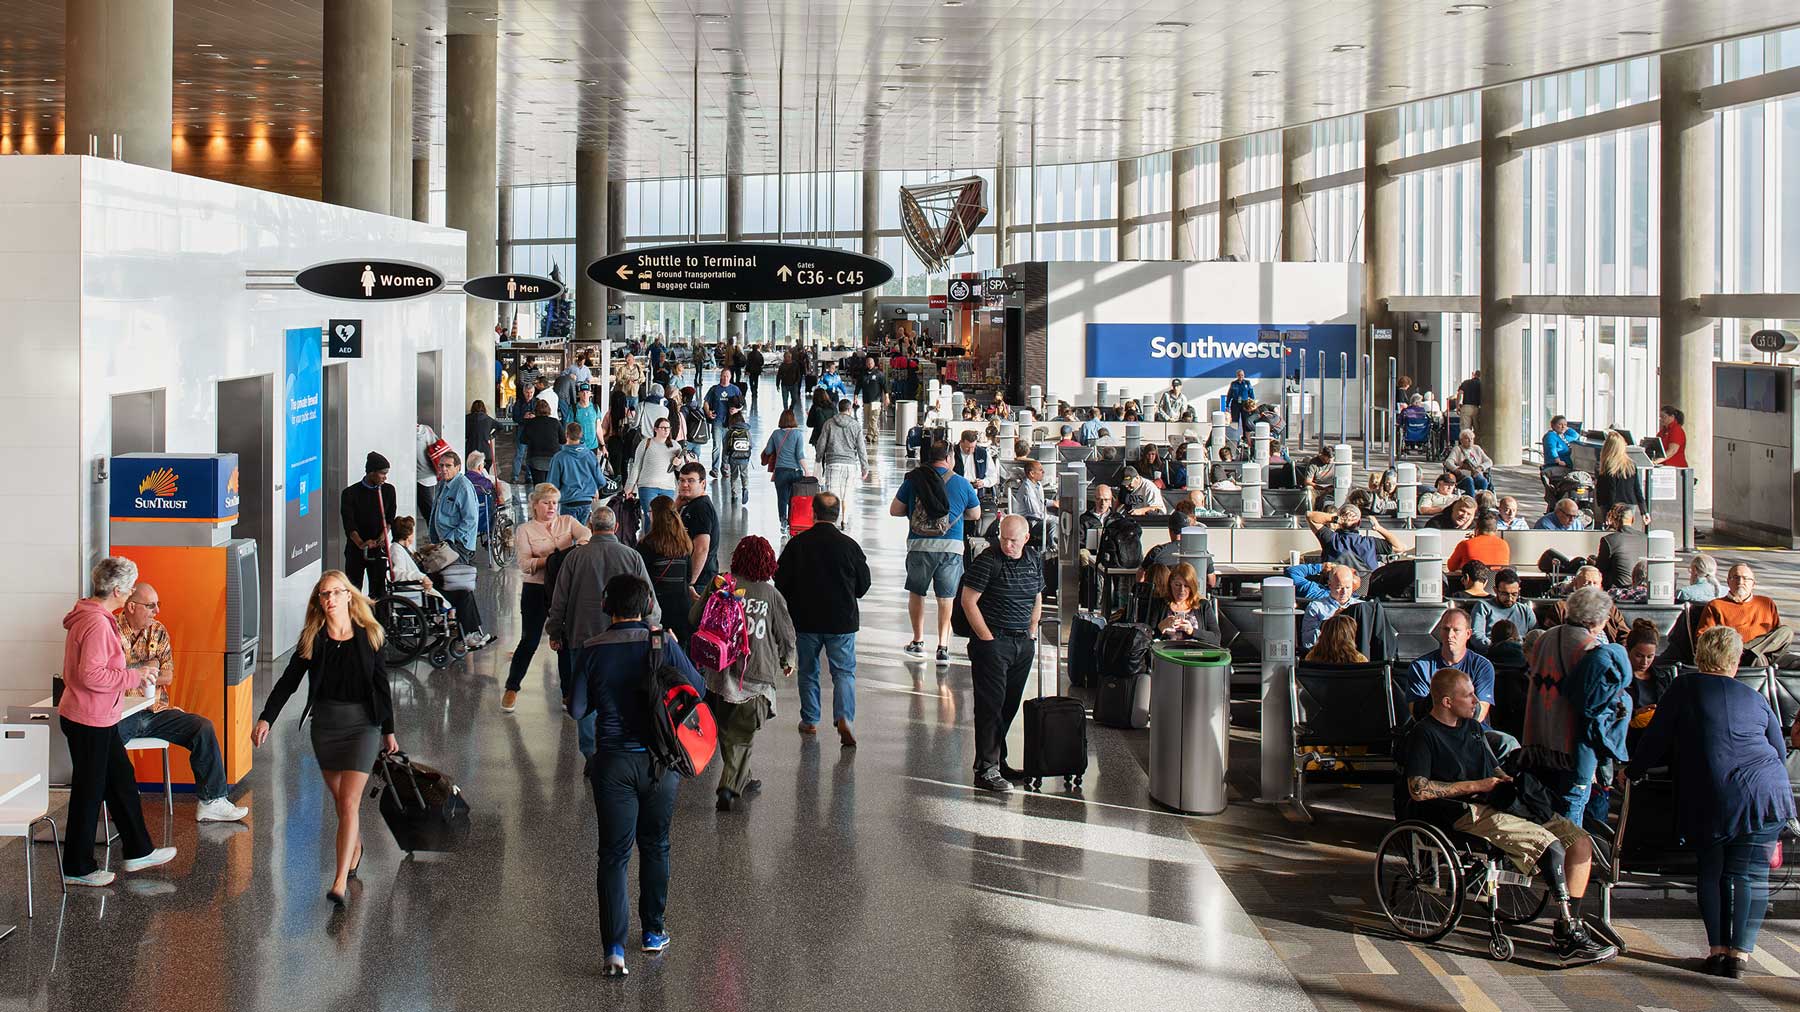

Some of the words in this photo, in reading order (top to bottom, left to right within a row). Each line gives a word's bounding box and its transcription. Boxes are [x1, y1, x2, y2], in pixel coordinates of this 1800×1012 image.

[637, 255, 681, 267] Shuttle
[686, 256, 698, 267] to
[703, 255, 757, 267] Terminal
[380, 274, 434, 287] Women
[684, 271, 737, 279] Transportation
[797, 270, 825, 285] C36
[836, 270, 864, 285] C45
[519, 284, 539, 293] Men
[656, 281, 688, 290] Baggage
[689, 281, 710, 289] Claim
[989, 280, 1008, 290] SPA
[1150, 335, 1283, 359] Southwest
